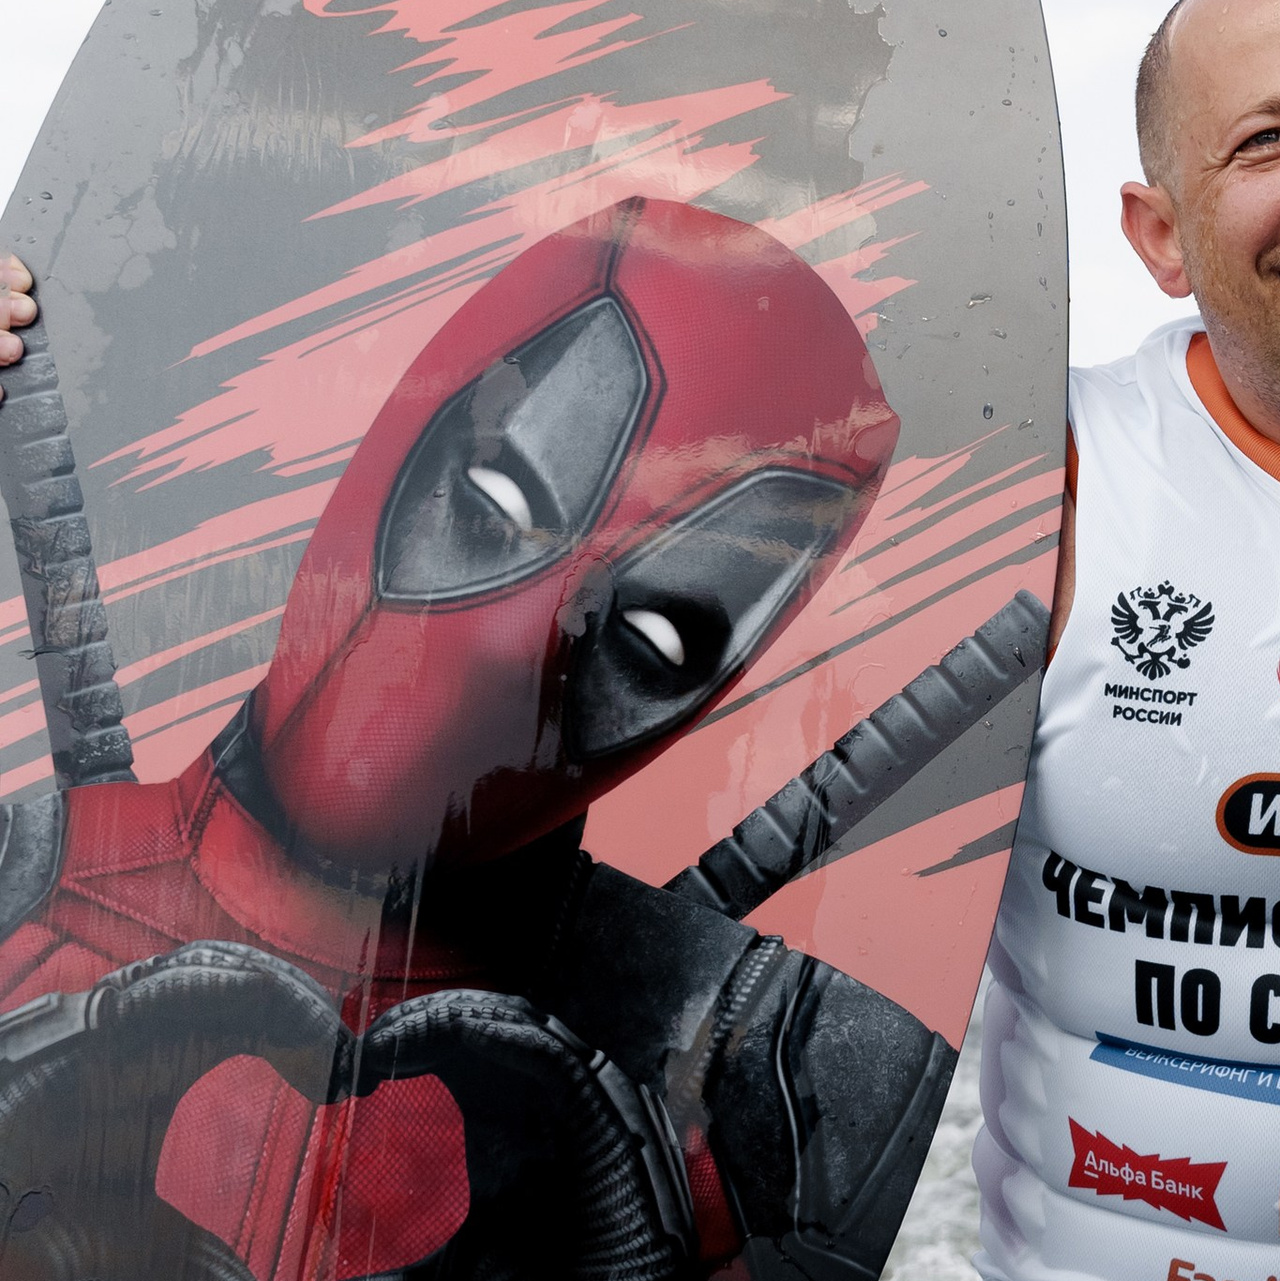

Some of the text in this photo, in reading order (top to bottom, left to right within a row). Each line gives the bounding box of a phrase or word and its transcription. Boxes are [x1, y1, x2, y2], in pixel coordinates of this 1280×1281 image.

[1104, 682, 1198, 707] МИНСПОРТ
[1112, 704, 1182, 726] РОССИИ
[1135, 959, 1222, 1036] ПО
[1257, 1071, 1272, 1087] И
[1083, 1150, 1204, 1200] Альфа Банк
